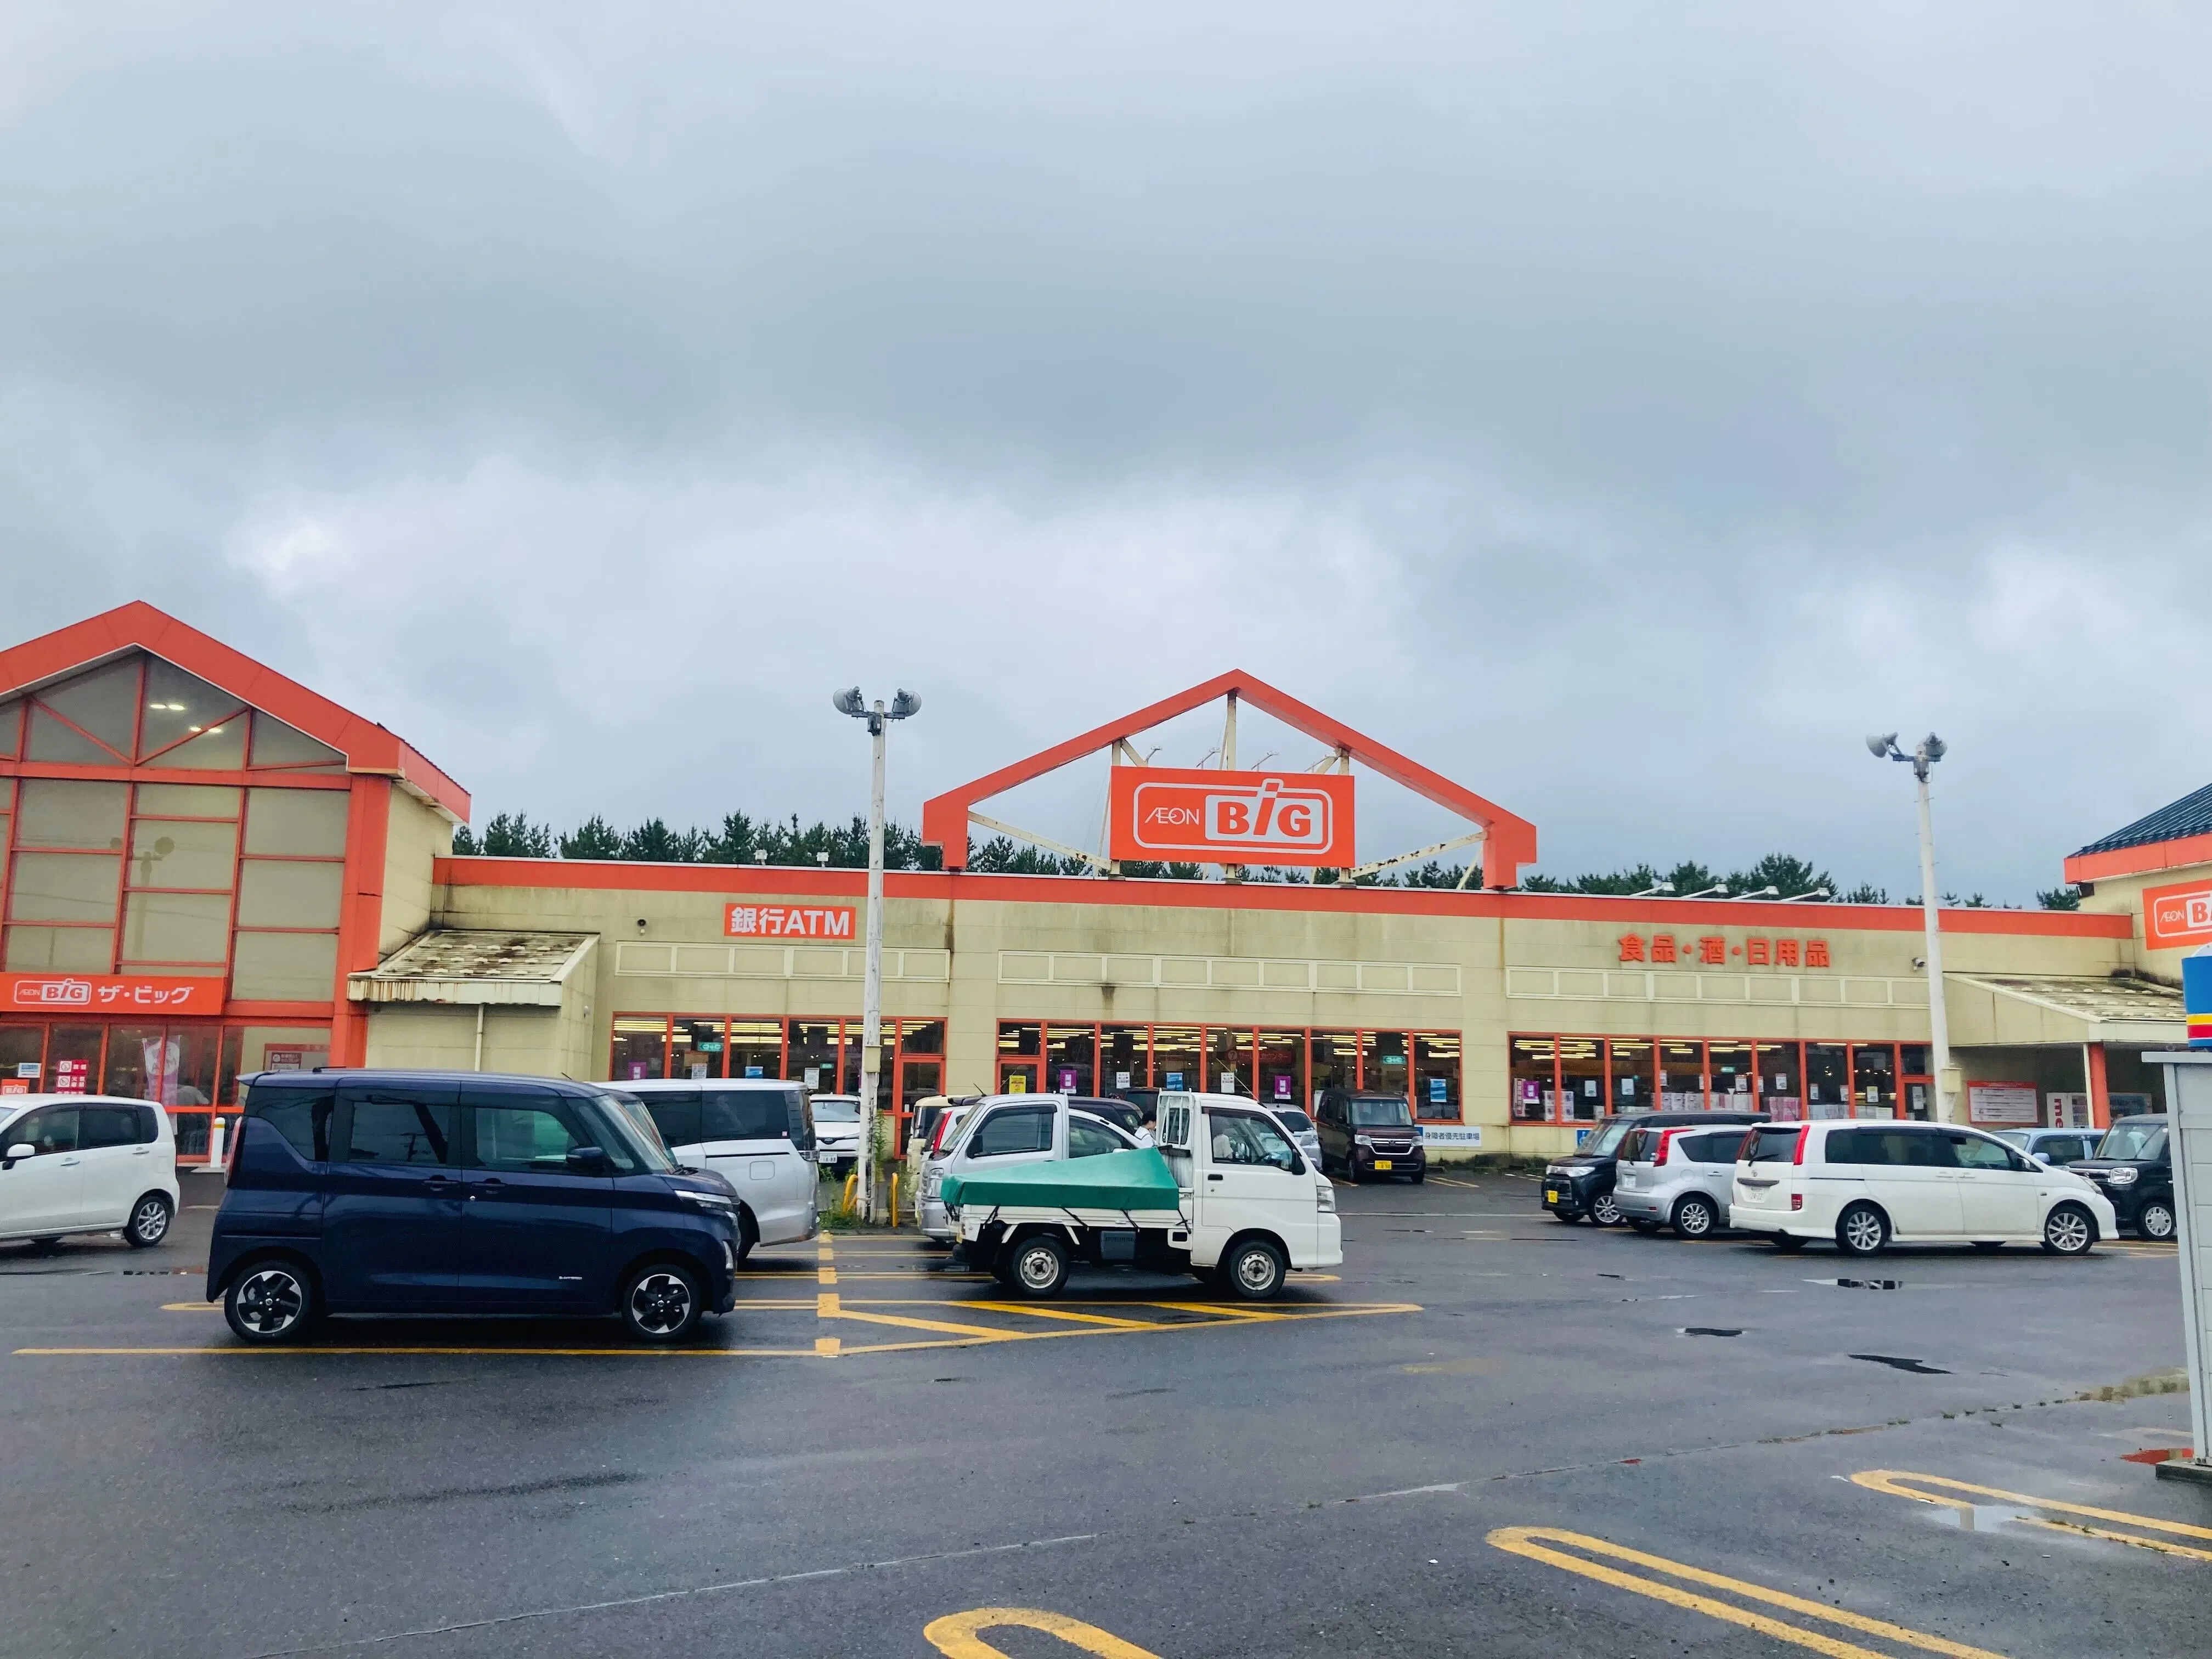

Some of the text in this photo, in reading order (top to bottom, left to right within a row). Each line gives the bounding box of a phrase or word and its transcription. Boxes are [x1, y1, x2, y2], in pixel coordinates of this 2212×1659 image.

[730, 906, 850, 936] 銀行ATM
[97, 985, 195, 1005] ザ・ビッグ
